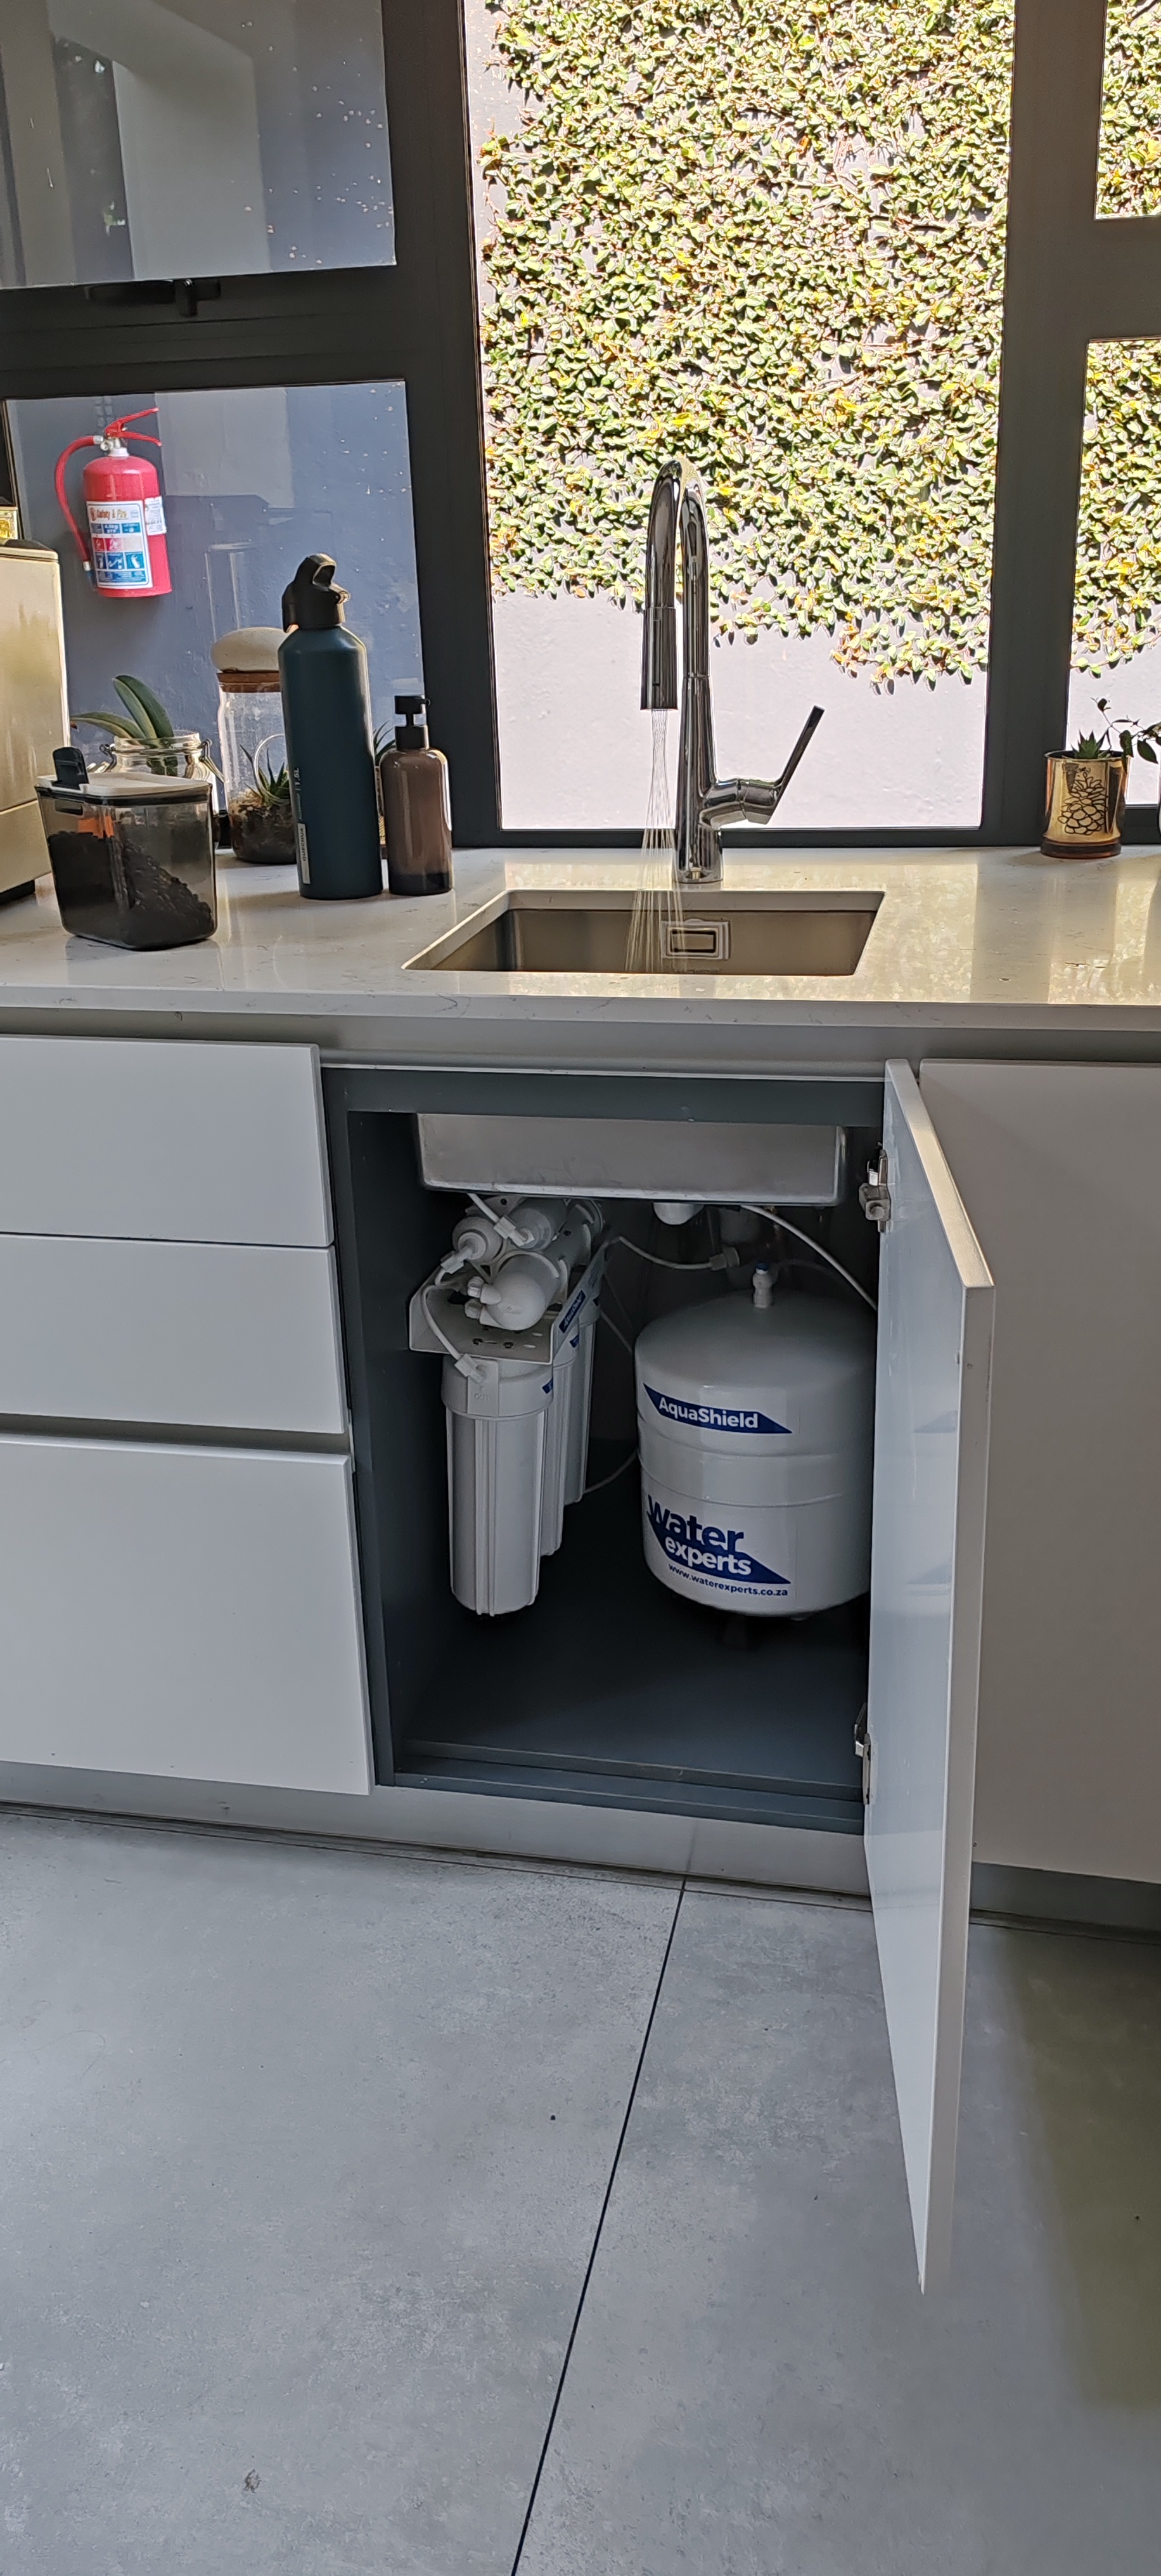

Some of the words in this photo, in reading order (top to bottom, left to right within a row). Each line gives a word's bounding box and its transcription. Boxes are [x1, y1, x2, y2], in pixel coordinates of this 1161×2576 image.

[658, 1396, 759, 1429] AquaShield
[647, 1495, 744, 1552] water
[665, 1536, 752, 1575] experts
[669, 1563, 788, 1597] www.waterexperts.co.za
